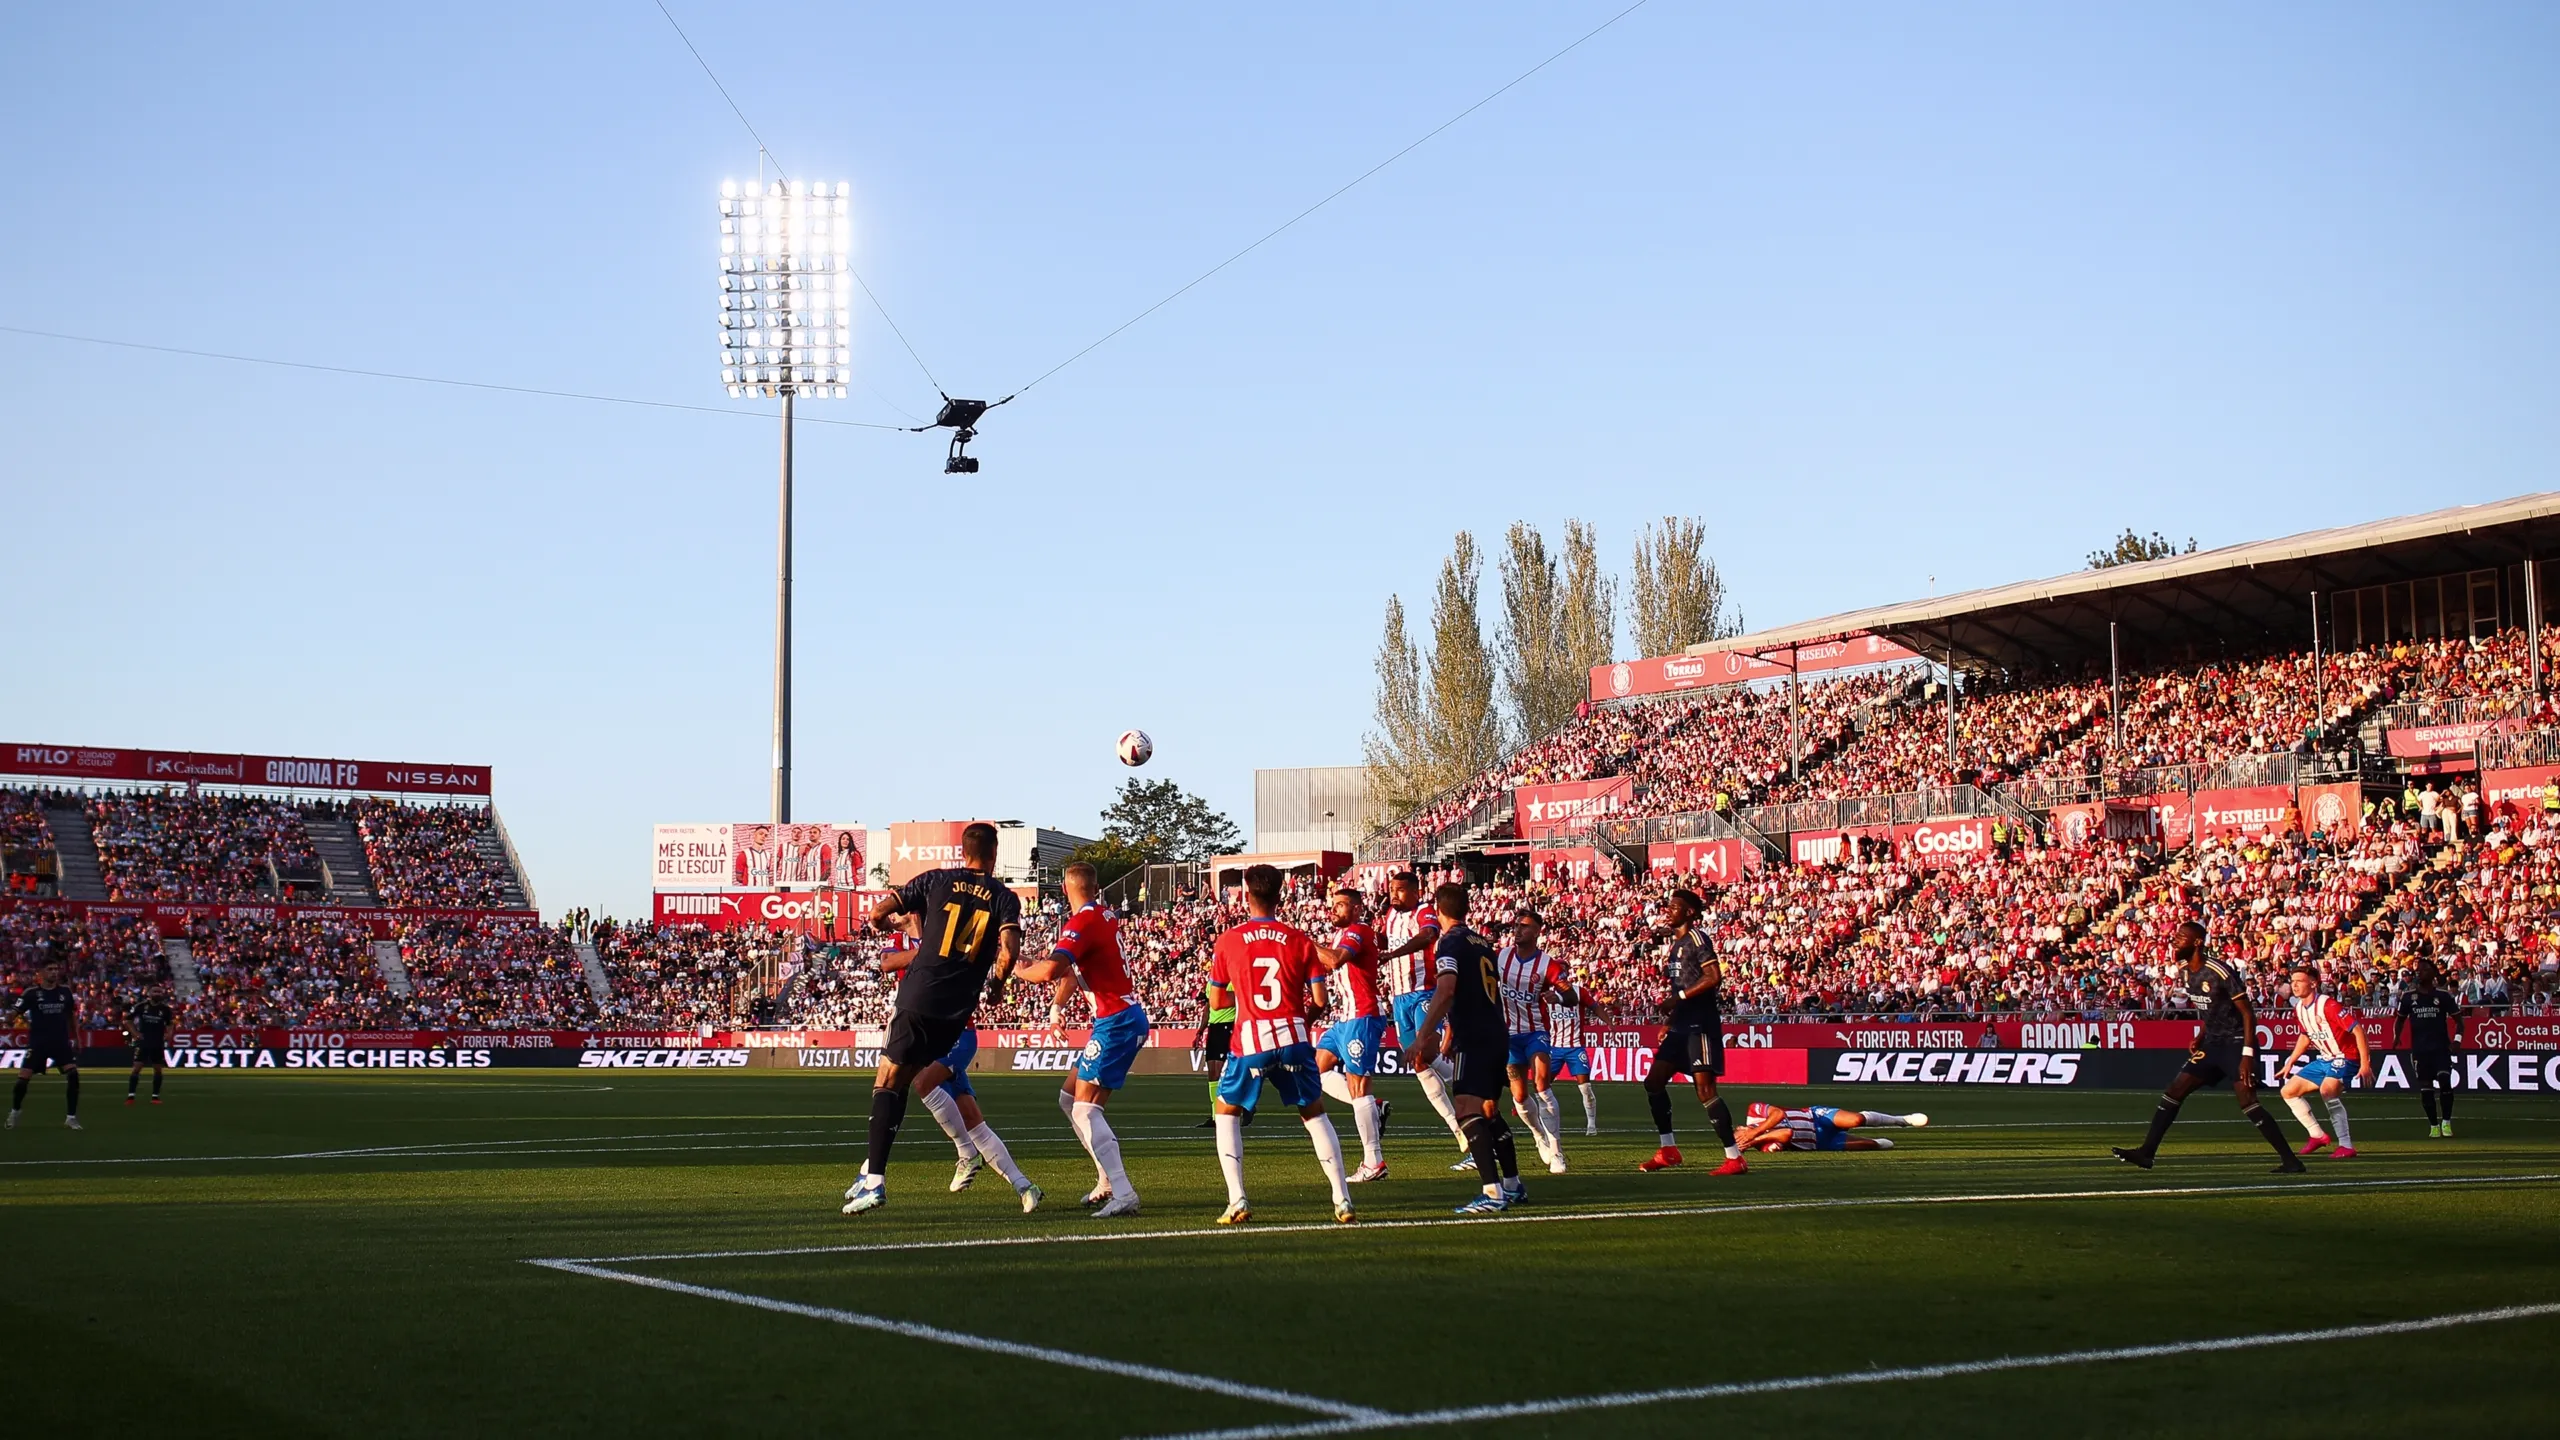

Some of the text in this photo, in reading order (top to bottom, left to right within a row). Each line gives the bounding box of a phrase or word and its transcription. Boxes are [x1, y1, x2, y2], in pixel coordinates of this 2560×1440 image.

[1666, 663, 1702, 678] TORRAS
[2415, 724, 2489, 742] BENVINGUTS
[2429, 737, 2480, 752] MONTIL
[17, 748, 69, 765] HYLO
[77, 751, 116, 760] CUIDADO
[174, 760, 235, 776] CaixaBank
[266, 761, 358, 786] GIRONA FC
[386, 771, 477, 786] NISSAN
[2502, 784, 2544, 802] parle
[1547, 796, 1618, 819] ESTRELLA
[2221, 807, 2285, 824] ESTRELLA
[1914, 822, 1983, 853] Gosbi
[659, 839, 727, 857] MÉS ENLLÀ
[917, 845, 963, 861] ESTRE
[659, 859, 673, 874] DE
[1576, 860, 1590, 880] FC
[952, 881, 992, 901] JOSELU
[157, 905, 186, 915] HYLO
[663, 895, 721, 915] PUMA
[761, 894, 839, 920] Gosbi
[358, 912, 413, 922] NISSAN
[938, 902, 991, 964] 14
[1242, 928, 1288, 946] MIGUEL
[1388, 936, 1410, 948] Gosb
[1252, 957, 1282, 1011] 3
[1479, 955, 1497, 1005] 6
[1501, 984, 1537, 1002] Gosbi
[1550, 1010, 1578, 1019] Gosbi
[1721, 1025, 1773, 1048] osbi
[1856, 1030, 1968, 1048] FOREVER. FASTER.
[2021, 1023, 2136, 1048] GIRONA FC
[2515, 1025, 2549, 1036] Costa
[289, 1034, 344, 1048] HYLO
[604, 1036, 703, 1048] ESTRELLA DAMM
[744, 1032, 805, 1048] Natshi
[998, 1034, 1069, 1047] NISSAN
[1603, 1032, 1644, 1048] FASTER.
[2516, 1040, 2558, 1050] Pirineu
[163, 1049, 491, 1068] VISITA SKECHERS.ES
[578, 1049, 751, 1068] SKECHERS
[799, 1050, 850, 1067] VISITA
[1589, 1048, 1655, 1081] ALIG
[1832, 1052, 2081, 1085] SKECHERS
